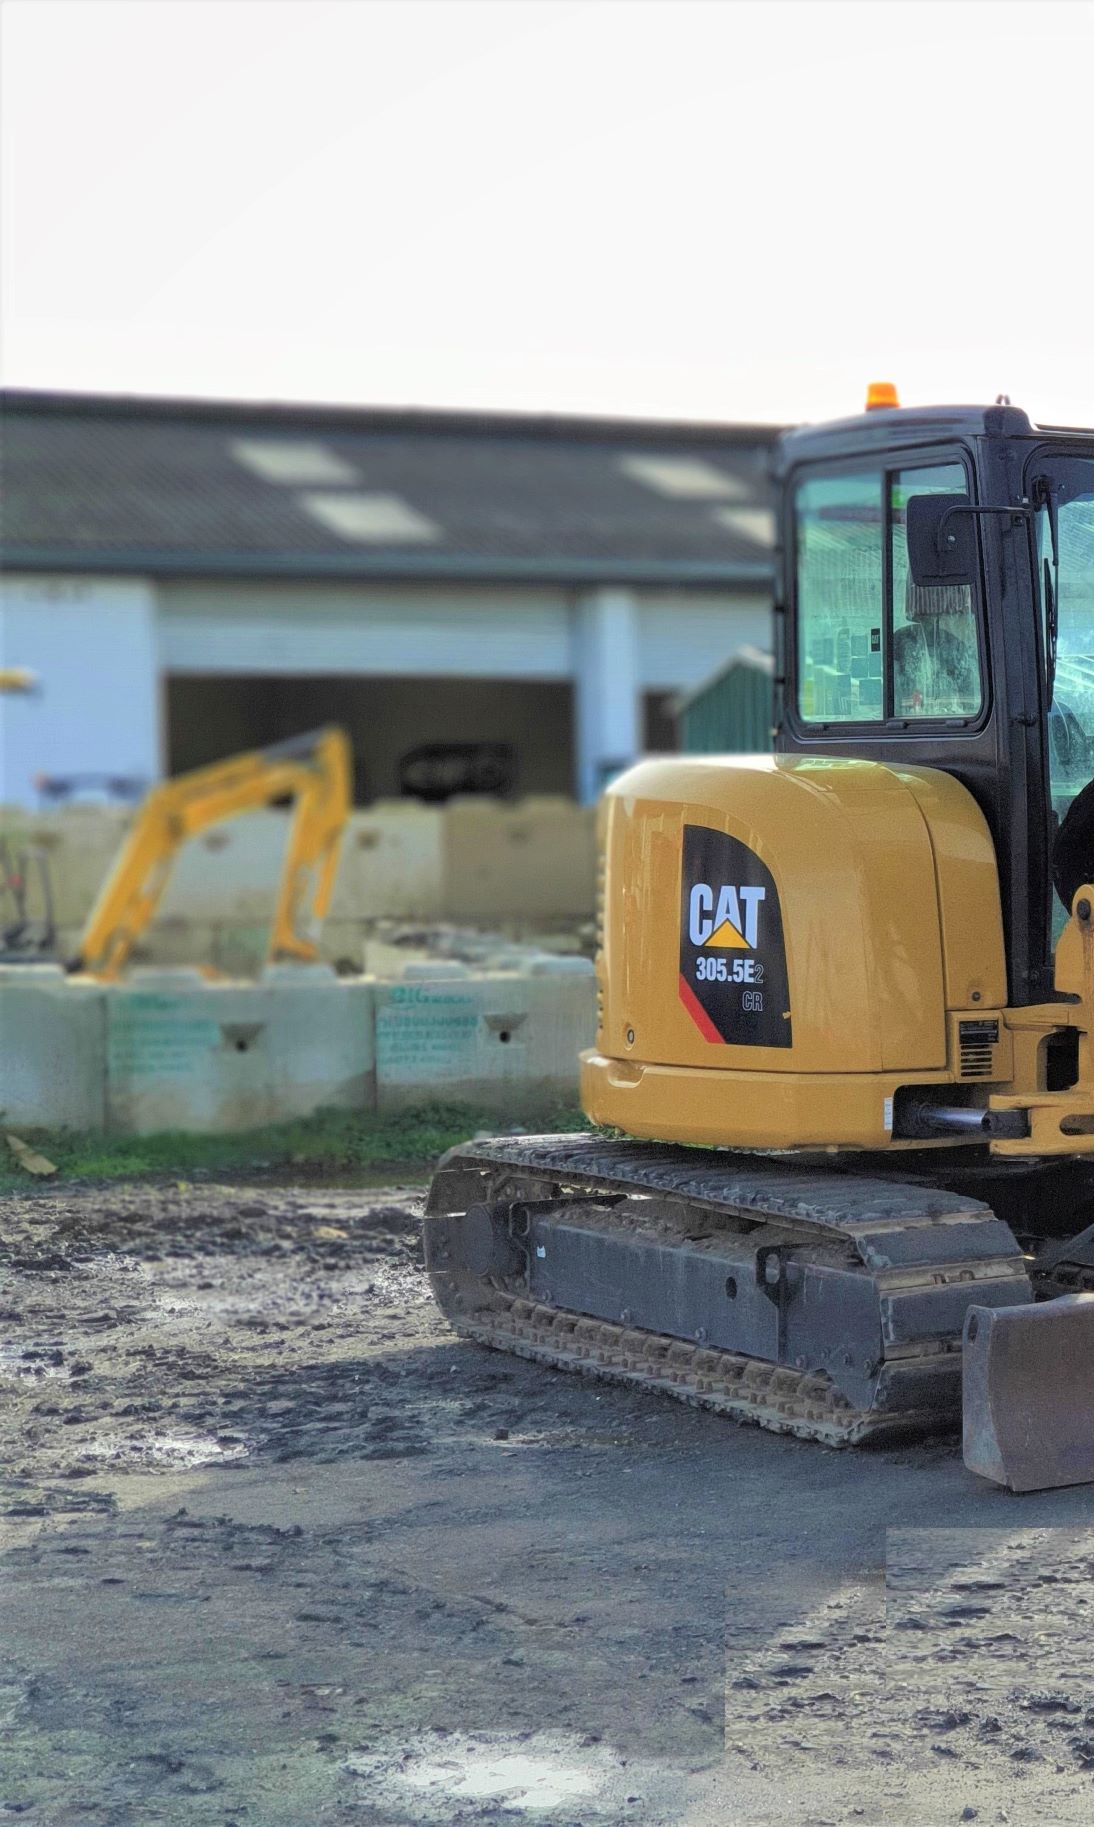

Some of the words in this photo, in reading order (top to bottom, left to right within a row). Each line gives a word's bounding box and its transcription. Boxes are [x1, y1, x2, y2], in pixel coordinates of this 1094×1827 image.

[689, 883, 766, 949] CAT
[696, 956, 764, 984] 305.5E2
[742, 991, 764, 1012] CR
